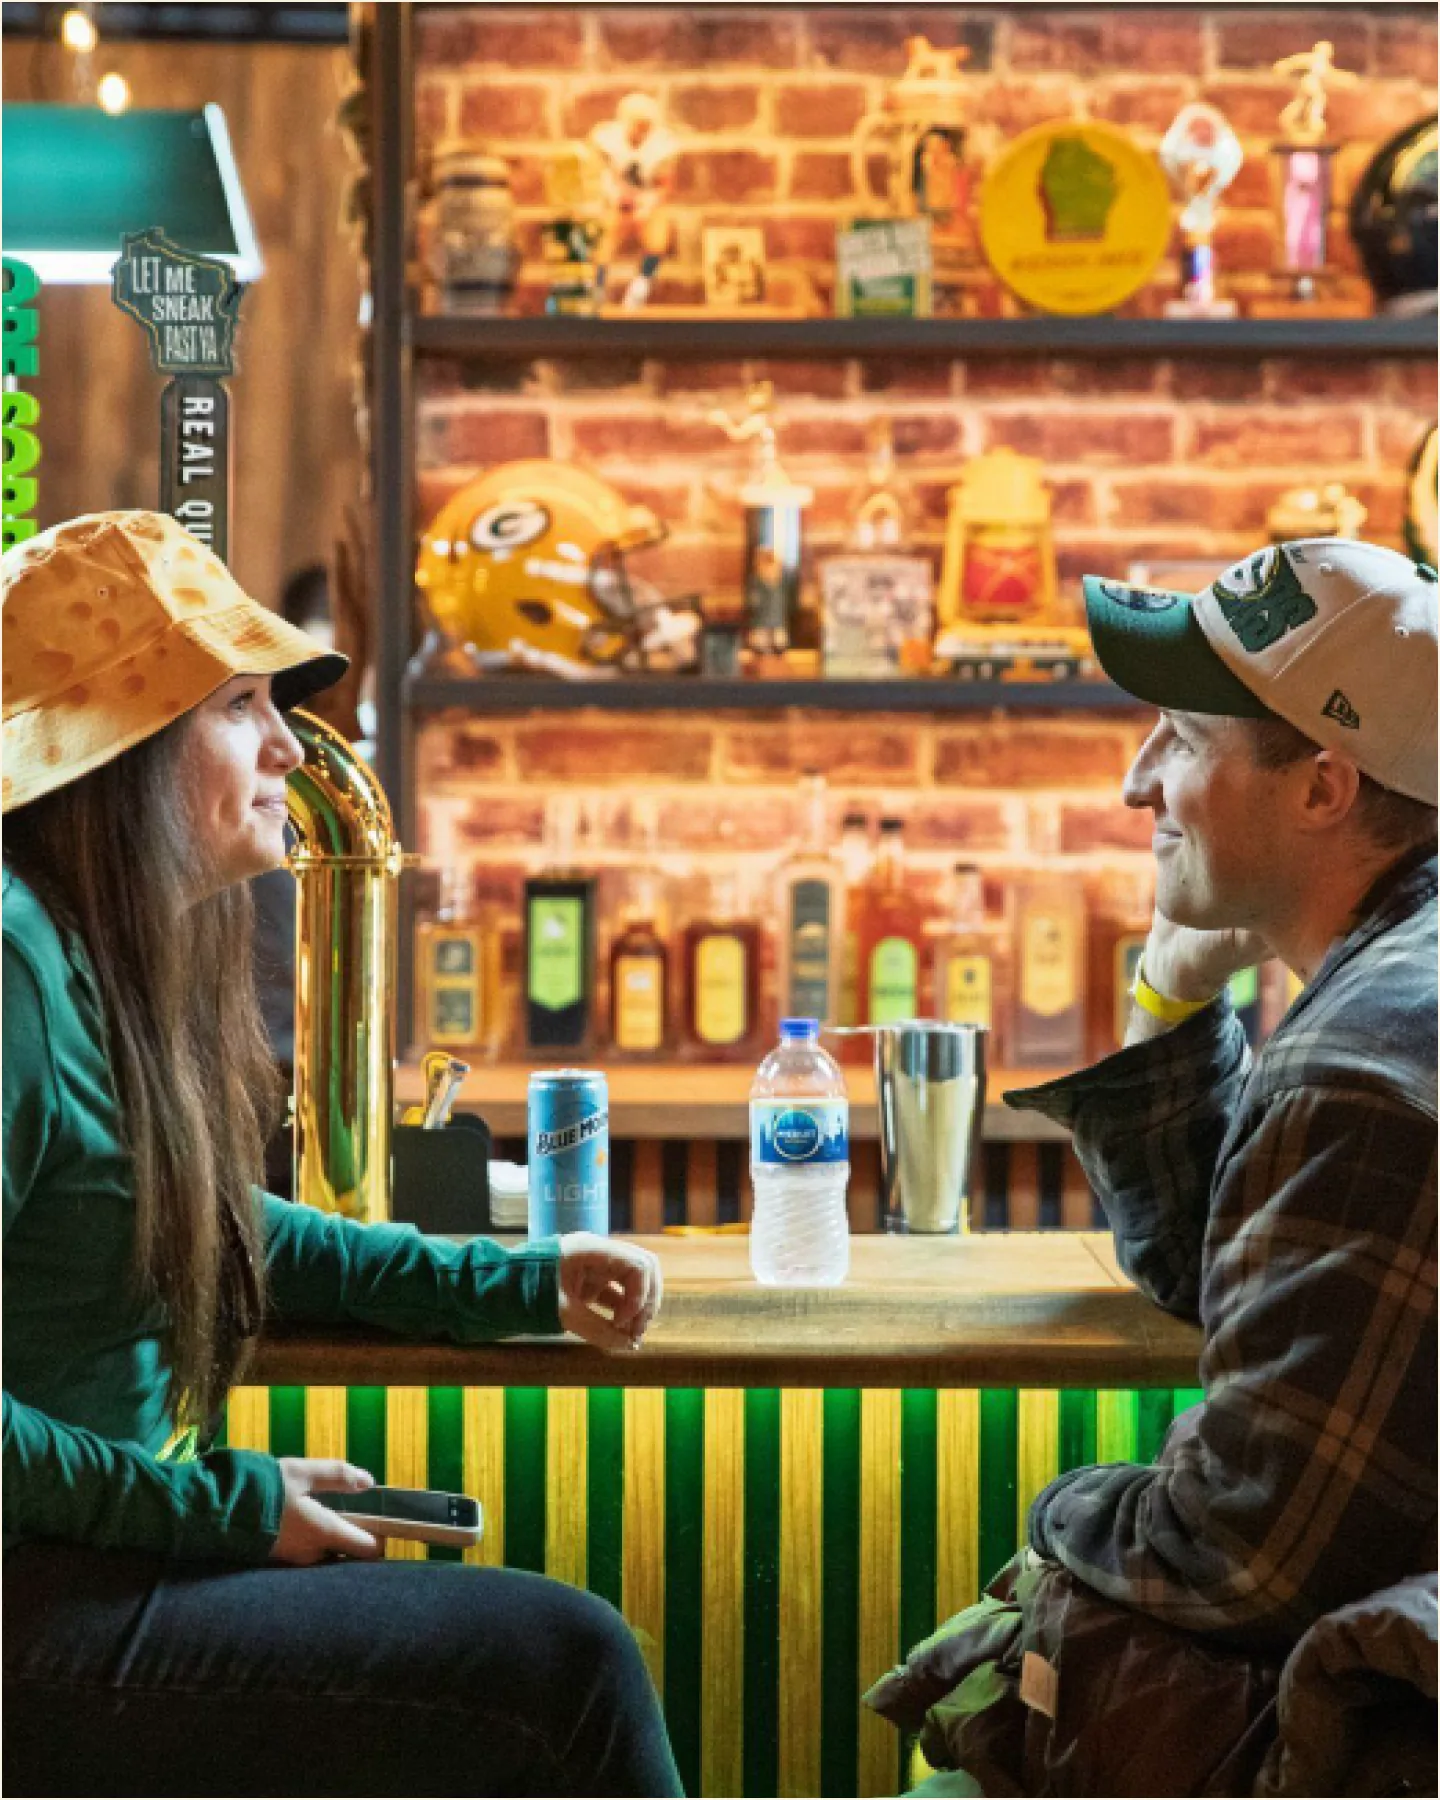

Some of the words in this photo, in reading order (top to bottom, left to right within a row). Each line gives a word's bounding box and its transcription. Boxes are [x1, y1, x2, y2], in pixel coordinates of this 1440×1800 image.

[131, 256, 162, 294] LET
[165, 265, 197, 294] ME
[151, 295, 215, 321] SNEAK
[182, 396, 214, 484] REAL
[175, 499, 214, 550] QU
[536, 1128, 576, 1155] BLUE
